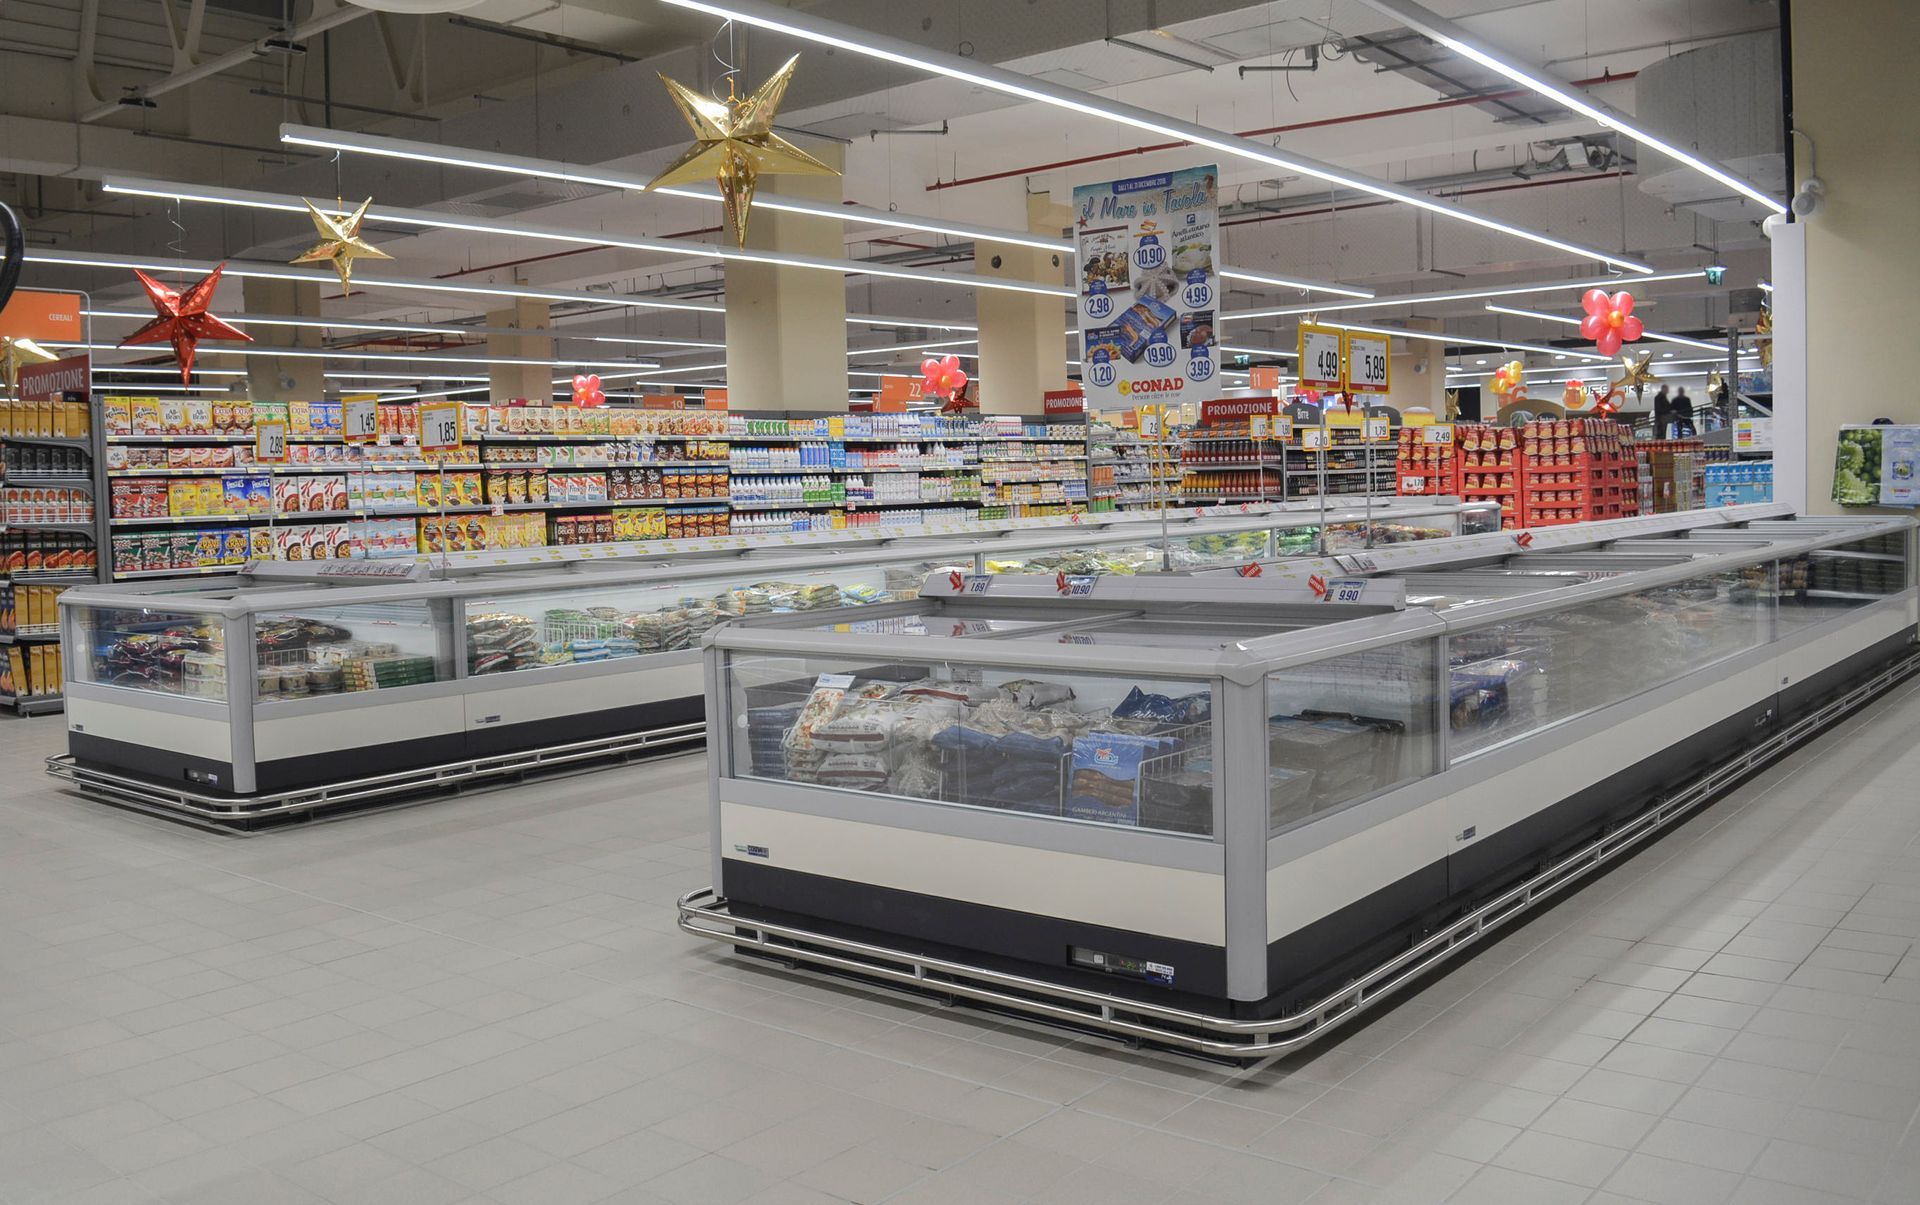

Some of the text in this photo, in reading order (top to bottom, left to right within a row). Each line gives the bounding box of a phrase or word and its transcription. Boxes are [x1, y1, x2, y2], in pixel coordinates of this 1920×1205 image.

[1100, 196, 1138, 219] Mare
[1143, 201, 1157, 217] in
[1163, 182, 1208, 214] Tavola
[1137, 247, 1163, 265] 10,90
[1186, 286, 1208, 303] 4,99
[1089, 297, 1110, 315] 2,98
[1147, 346, 1173, 364] 19,90
[1190, 360, 1211, 377] 3,99
[1318, 350, 1338, 380] 4,99
[1365, 355, 1385, 383] 5,89
[22, 368, 84, 396] PROMOZIONE
[1093, 366, 1112, 383] 1,20
[909, 382, 920, 397] 22
[1131, 377, 1184, 393] CONAD
[1046, 397, 1083, 409] PROMOZIONE
[1207, 402, 1273, 416] PROMOZIONE
[1297, 408, 1310, 420] Birre
[360, 413, 375, 435] 1,45
[438, 422, 456, 445] 1,85
[1436, 431, 1450, 443] 2,49
[270, 436, 283, 455] 2,89
[275, 479, 291, 498] K
[301, 478, 316, 498] K
[324, 478, 339, 497] K
[278, 528, 292, 548] K
[301, 527, 316, 546] K
[326, 526, 342, 546] K
[1309, 577, 1324, 593] OFFERTA
[1338, 590, 1359, 601] 9.90
